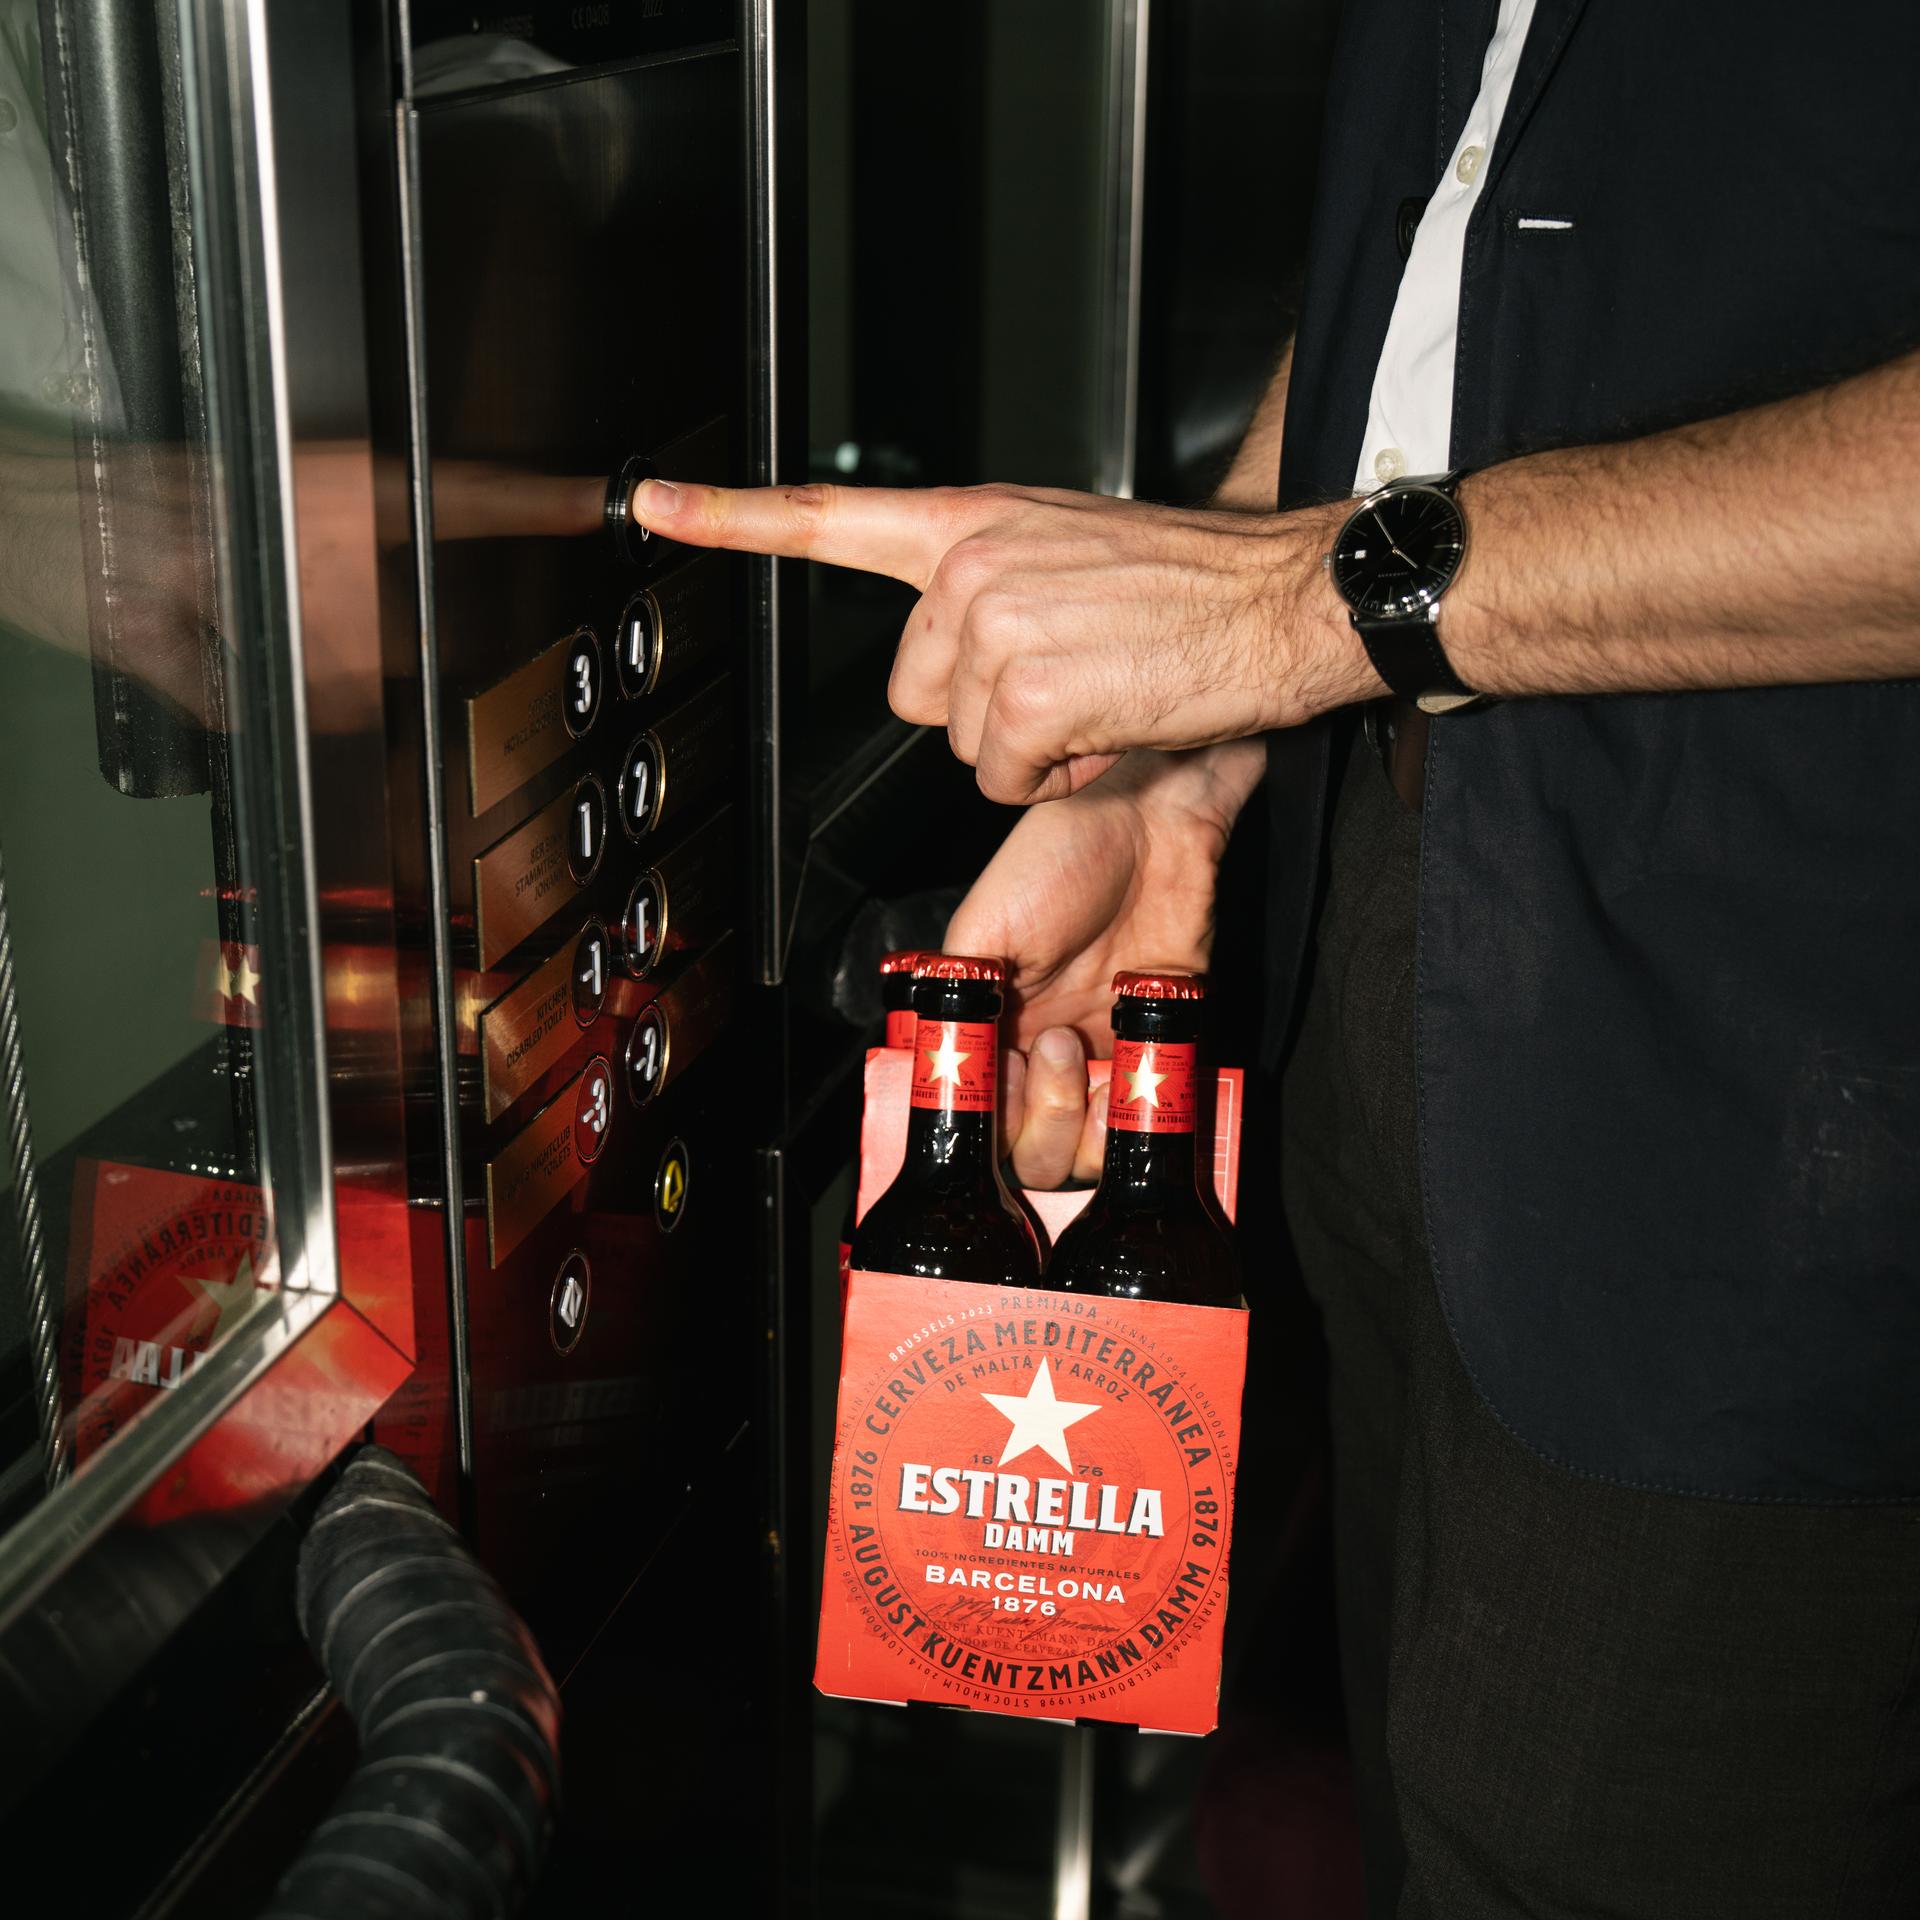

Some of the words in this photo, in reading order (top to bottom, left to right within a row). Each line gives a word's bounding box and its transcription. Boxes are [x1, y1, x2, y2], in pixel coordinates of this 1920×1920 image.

[628, 620, 646, 675] 4
[573, 654, 592, 714] 3
[632, 760, 649, 818] 2
[577, 801, 592, 858] 1
[634, 896, 651, 955] E
[579, 939, 602, 996] -1
[537, 983, 568, 1022] KITCHEN
[507, 1026, 543, 1069] DISABLED
[543, 1002, 568, 1034] TOILET
[634, 1025, 658, 1083] -2
[580, 1076, 607, 1134] -3
[531, 1125, 571, 1173] NIGHTCLUB
[543, 1143, 572, 1178] TOILETS
[1000, 1295, 1098, 1319] PREMIADA
[888, 1314, 955, 1362] BRUSSELS
[960, 1305, 993, 1320] 2023
[1105, 1315, 1157, 1351] VIENNA
[1159, 1352, 1188, 1378] 1904
[865, 1327, 988, 1436] CERVEZA
[994, 1318, 1212, 1468] MEDITERRÁNEA
[944, 1372, 968, 1393] DE
[972, 1355, 1033, 1379] MALTA
[1054, 1357, 1064, 1371] Y
[1070, 1363, 1131, 1403] ARROZ
[838, 1397, 863, 1448] BERLIN
[1188, 1382, 1226, 1439] LONDON
[1220, 1444, 1236, 1478] 1905
[850, 1448, 879, 1510] 1876
[972, 1454, 994, 1465] 18
[1077, 1465, 1104, 1477] 76
[898, 1463, 1165, 1537] ESTRELLA
[1192, 1485, 1219, 1548] 1876
[915, 1549, 949, 1560] 100%
[953, 1553, 1056, 1571] INGREDIENTES
[1059, 1565, 1141, 1580] NATURALES
[984, 1522, 1075, 1556] DAMM
[842, 1571, 861, 1602] 2018
[849, 1523, 927, 1639] AUGUST
[921, 1631, 1143, 1691] KUENTZMANN
[1138, 1560, 1211, 1650] DAMM
[925, 1563, 1126, 1604] BARCELONA
[991, 1595, 1057, 1617] 1876
[860, 1605, 904, 1657] LONDON
[1193, 1590, 1221, 1631] PARIS
[908, 1657, 939, 1680] 2014
[1166, 1633, 1193, 1660] 1964
[942, 1678, 1030, 1708] STOCKHOLM
[1040, 1697, 1072, 1708] 1998
[1079, 1661, 1162, 1705] MELBOURNE
